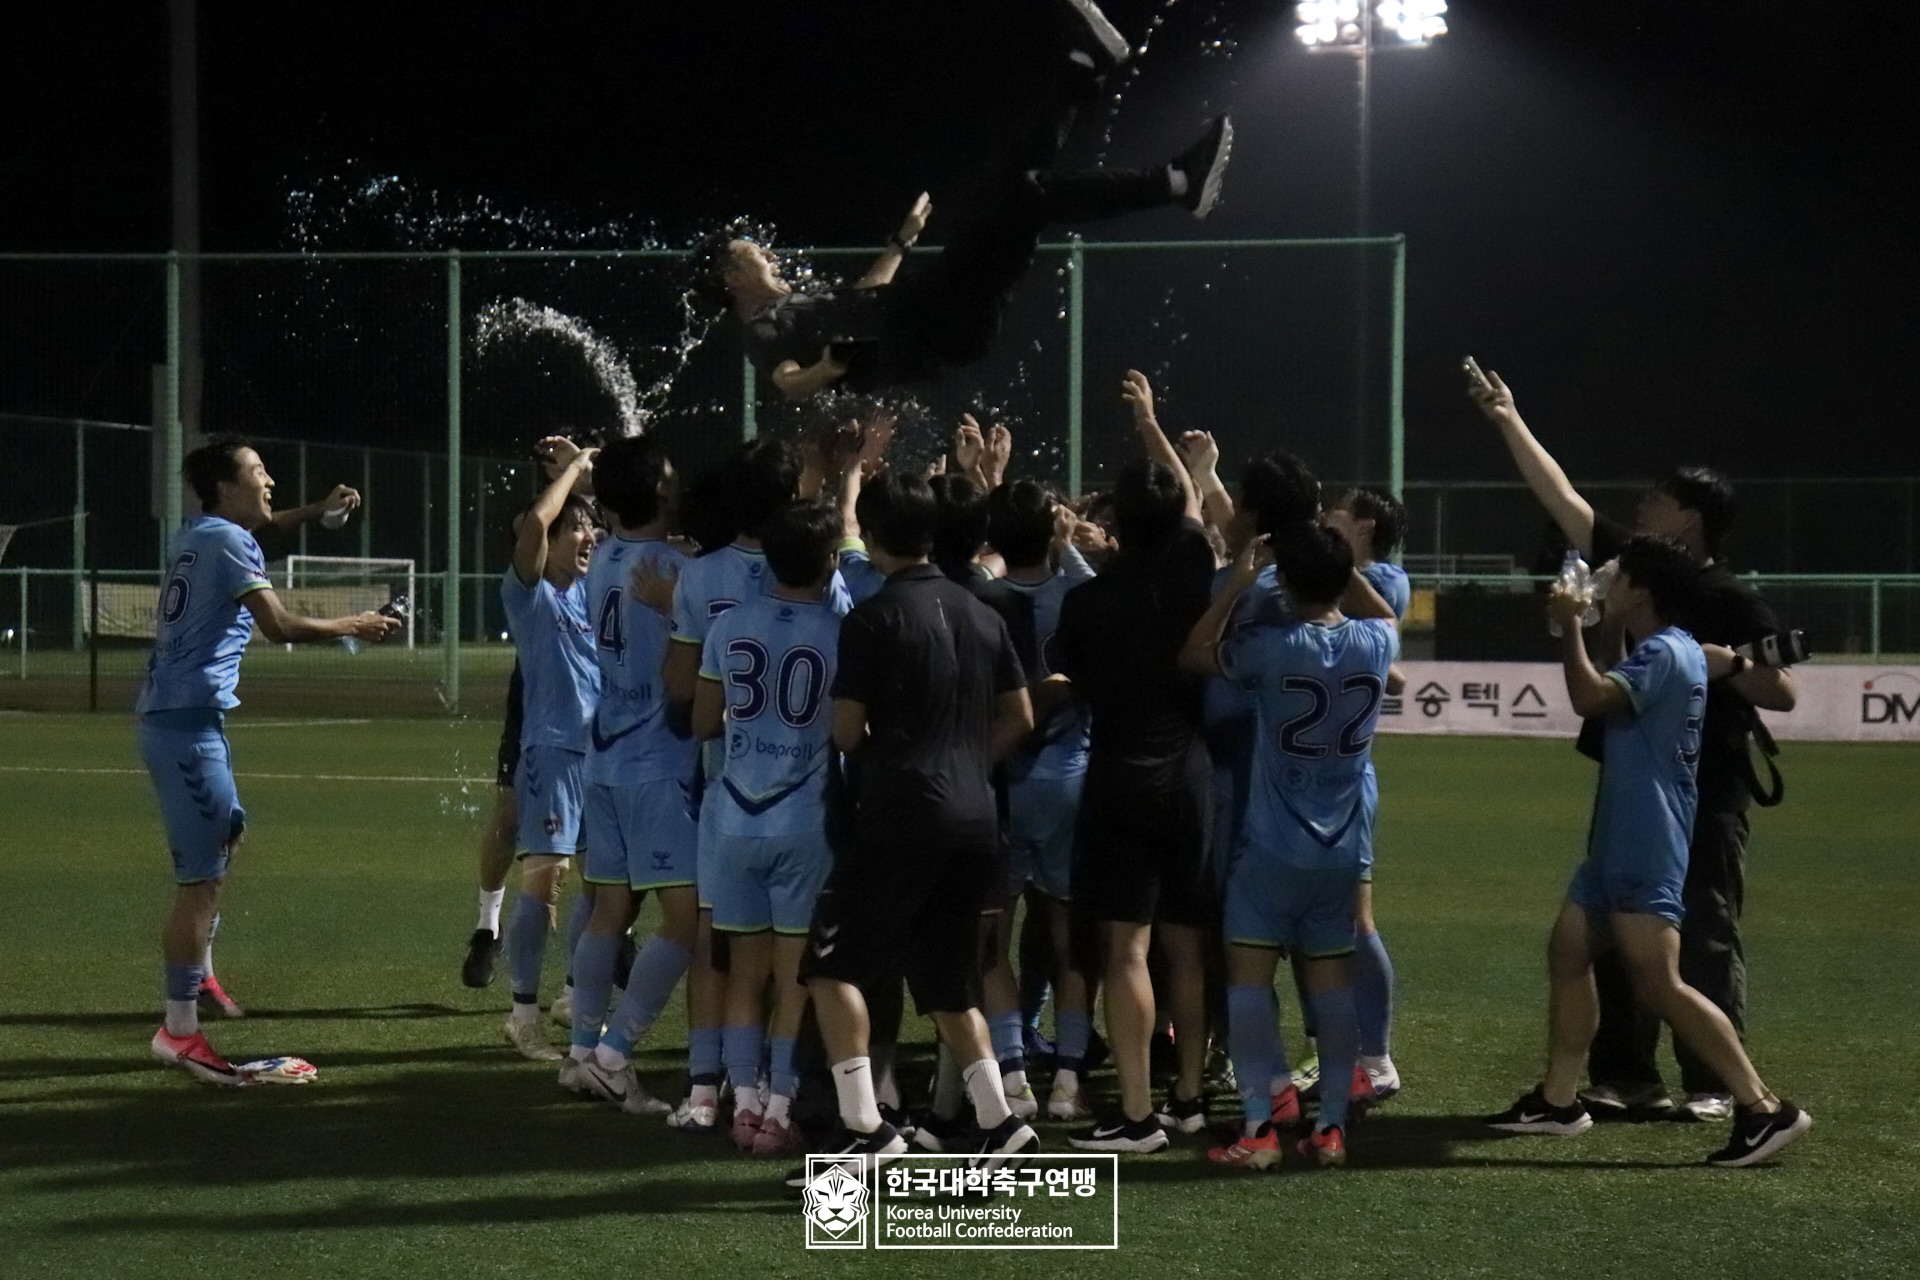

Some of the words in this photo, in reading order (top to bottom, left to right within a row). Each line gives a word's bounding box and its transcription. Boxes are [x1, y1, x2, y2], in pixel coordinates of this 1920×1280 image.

[727, 638, 827, 729] 30
[1279, 672, 1384, 760] 22
[756, 737, 813, 760] beproll
